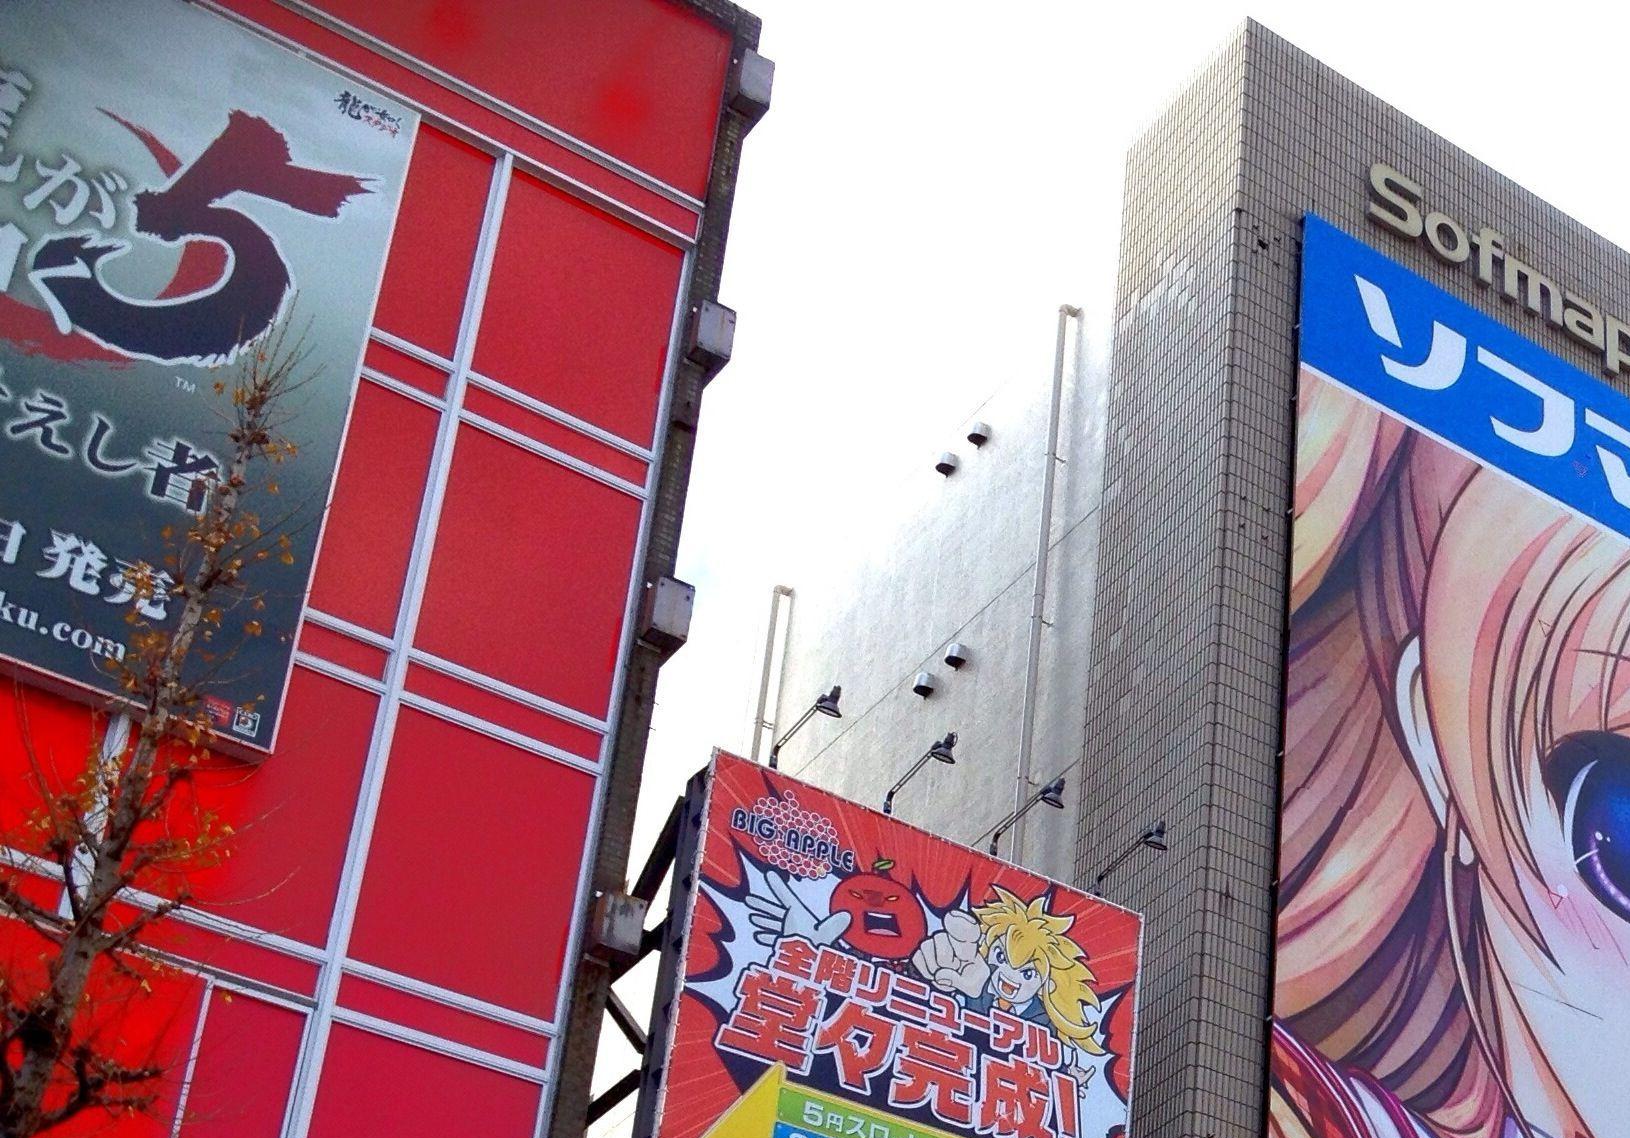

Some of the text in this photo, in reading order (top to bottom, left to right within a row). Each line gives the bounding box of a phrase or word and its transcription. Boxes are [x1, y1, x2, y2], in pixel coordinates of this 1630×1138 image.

[174, 376, 197, 394] TM
[0, 380, 224, 515] えし者
[731, 807, 855, 872] BIG APPLE
[769, 938, 1063, 1067] 全階リニューアル
